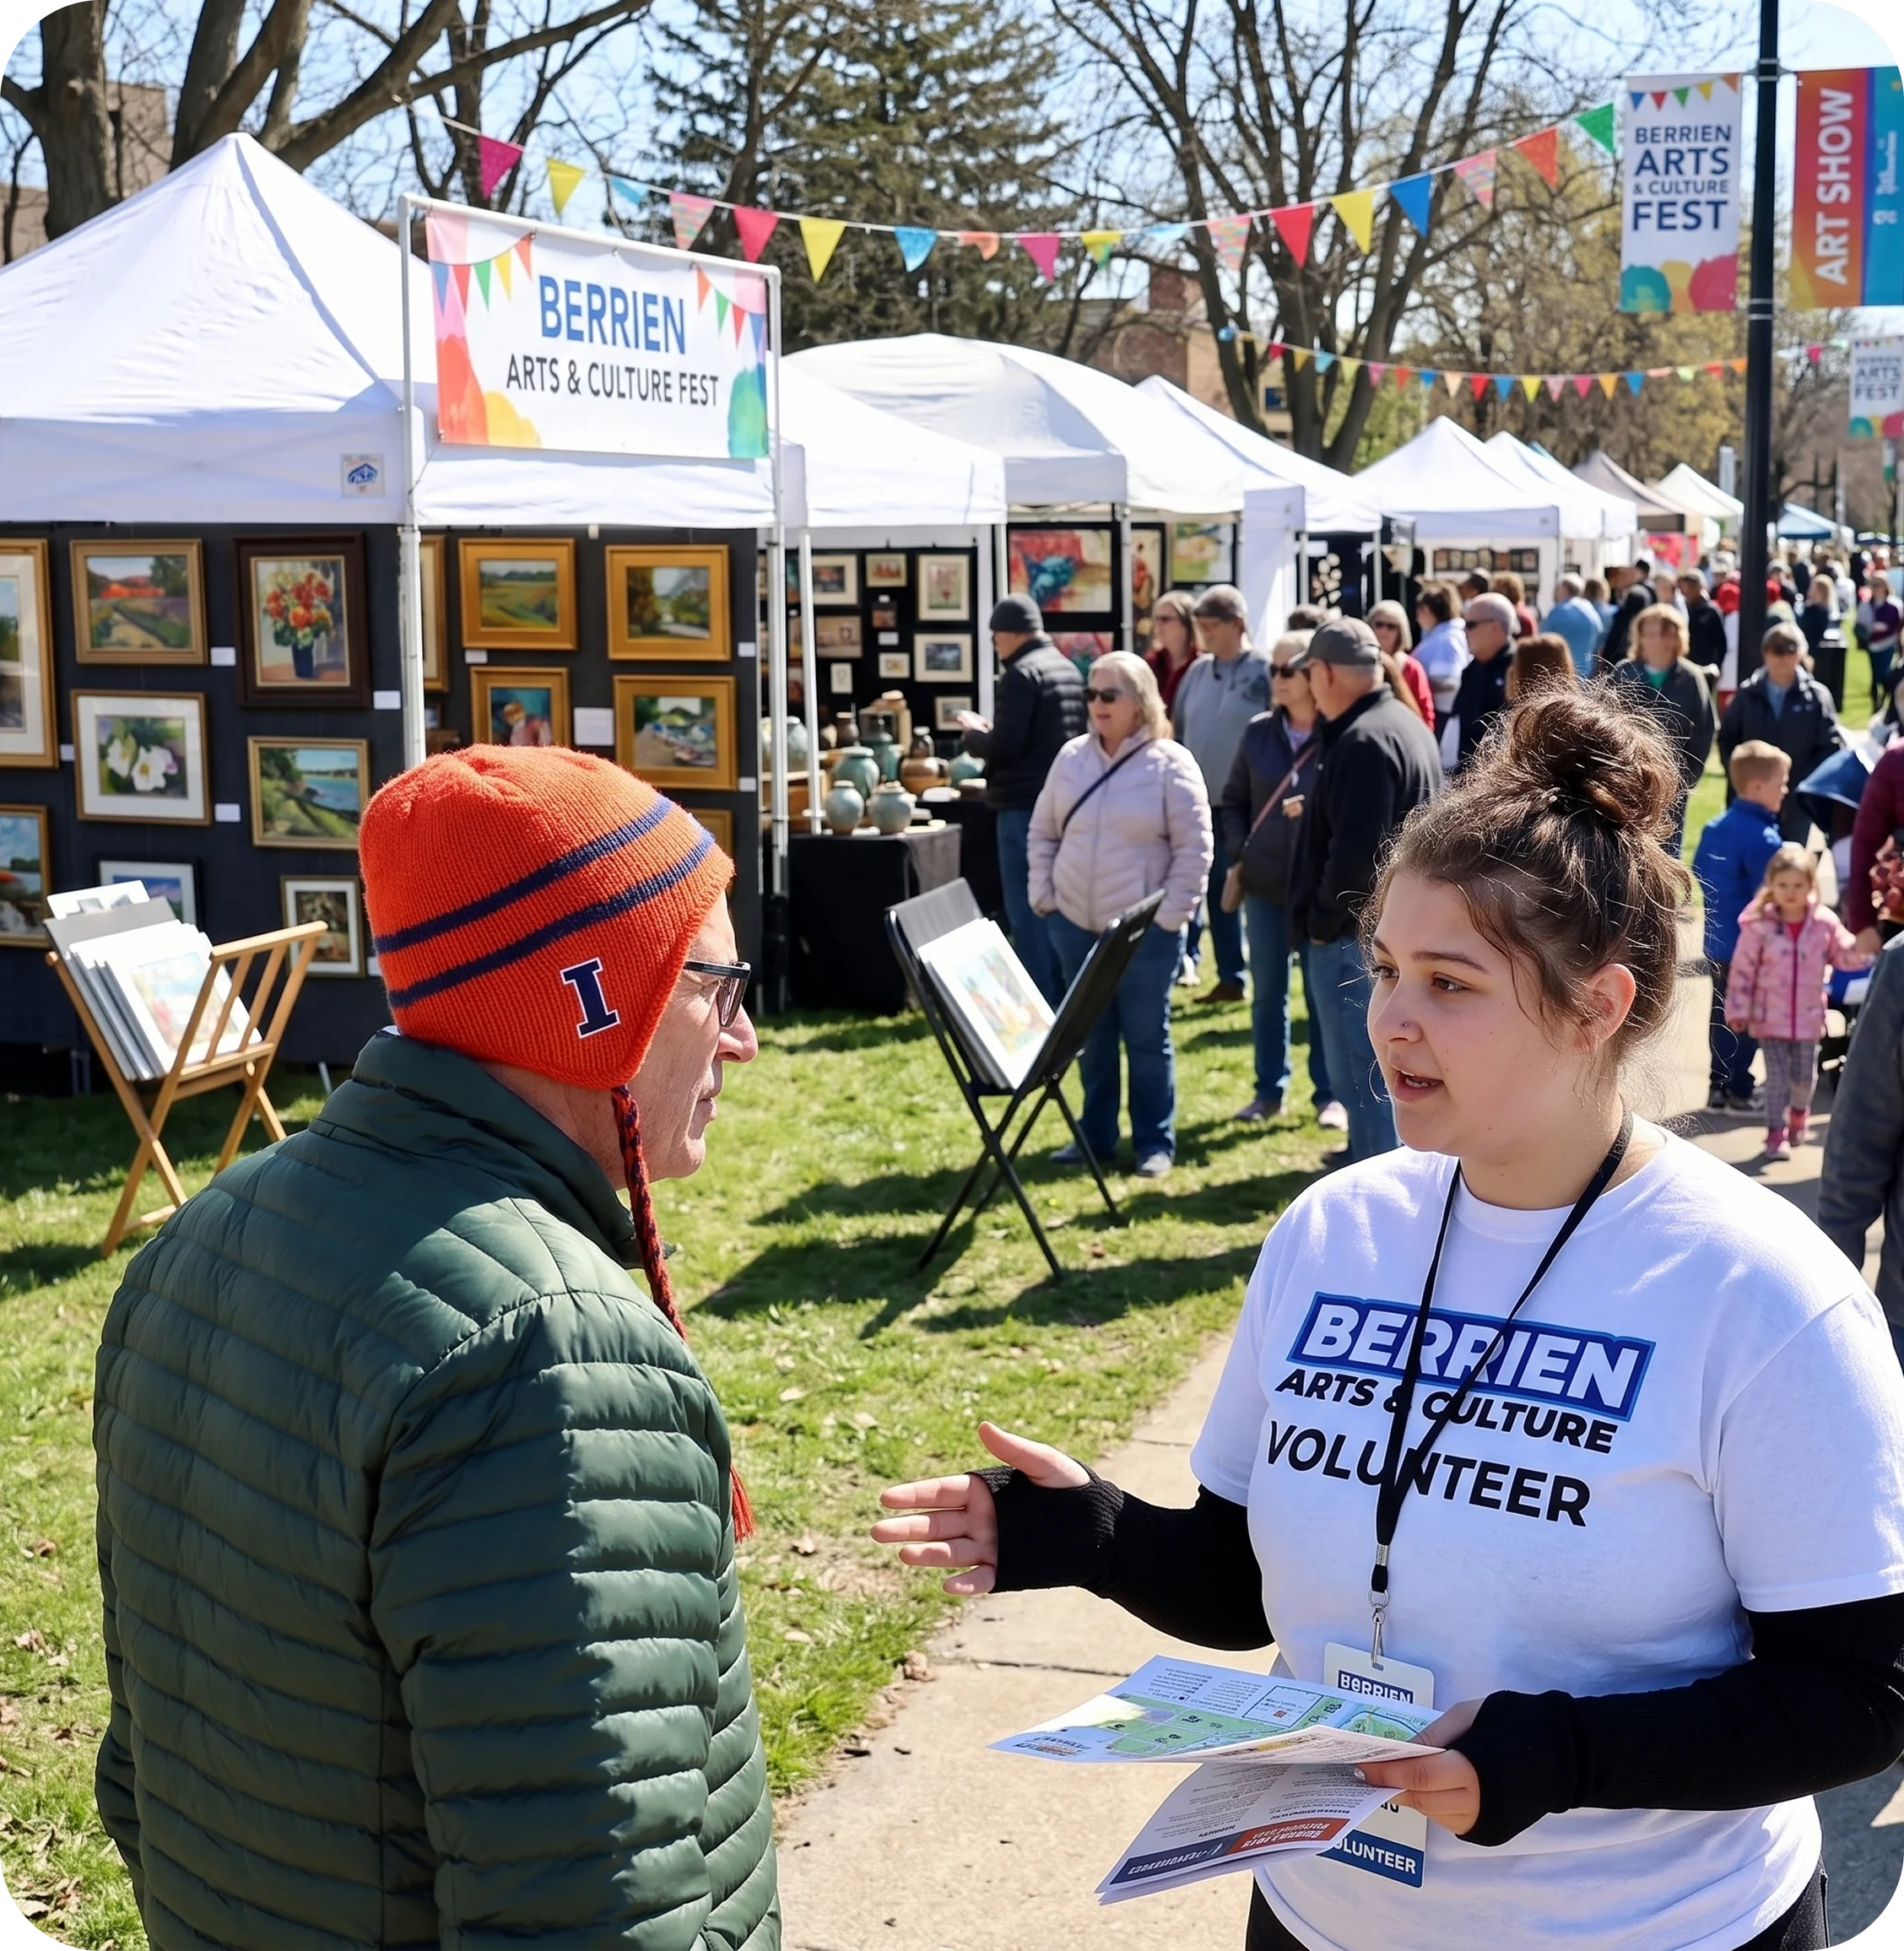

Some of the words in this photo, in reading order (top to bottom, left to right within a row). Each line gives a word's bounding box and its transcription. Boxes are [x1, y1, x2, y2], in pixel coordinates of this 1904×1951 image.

[1635, 125, 1731, 143] BERRIEN
[1816, 89, 1853, 203] SHOW
[1633, 182, 1644, 195] &
[1648, 179, 1730, 194] CULTURE
[1635, 147, 1729, 176] ARTS
[1632, 201, 1728, 231] FEST
[1815, 211, 1849, 285] ART
[538, 275, 686, 354] BERRIEN
[506, 354, 560, 392] ARTS
[567, 359, 581, 395] &
[587, 361, 673, 403] CULTURE
[679, 372, 718, 407] FEST
[1855, 366, 1901, 382] ARTS
[1855, 386, 1898, 401] FEST
[560, 956, 621, 1040] I
[1301, 1304, 1639, 1408] BERRIEN
[1274, 1368, 1379, 1408] ARTS
[1421, 1391, 1619, 1455] CULTURE
[1267, 1420, 1592, 1527] VOLUNTEER
[1333, 1837, 1416, 1874] OLUNTEER
